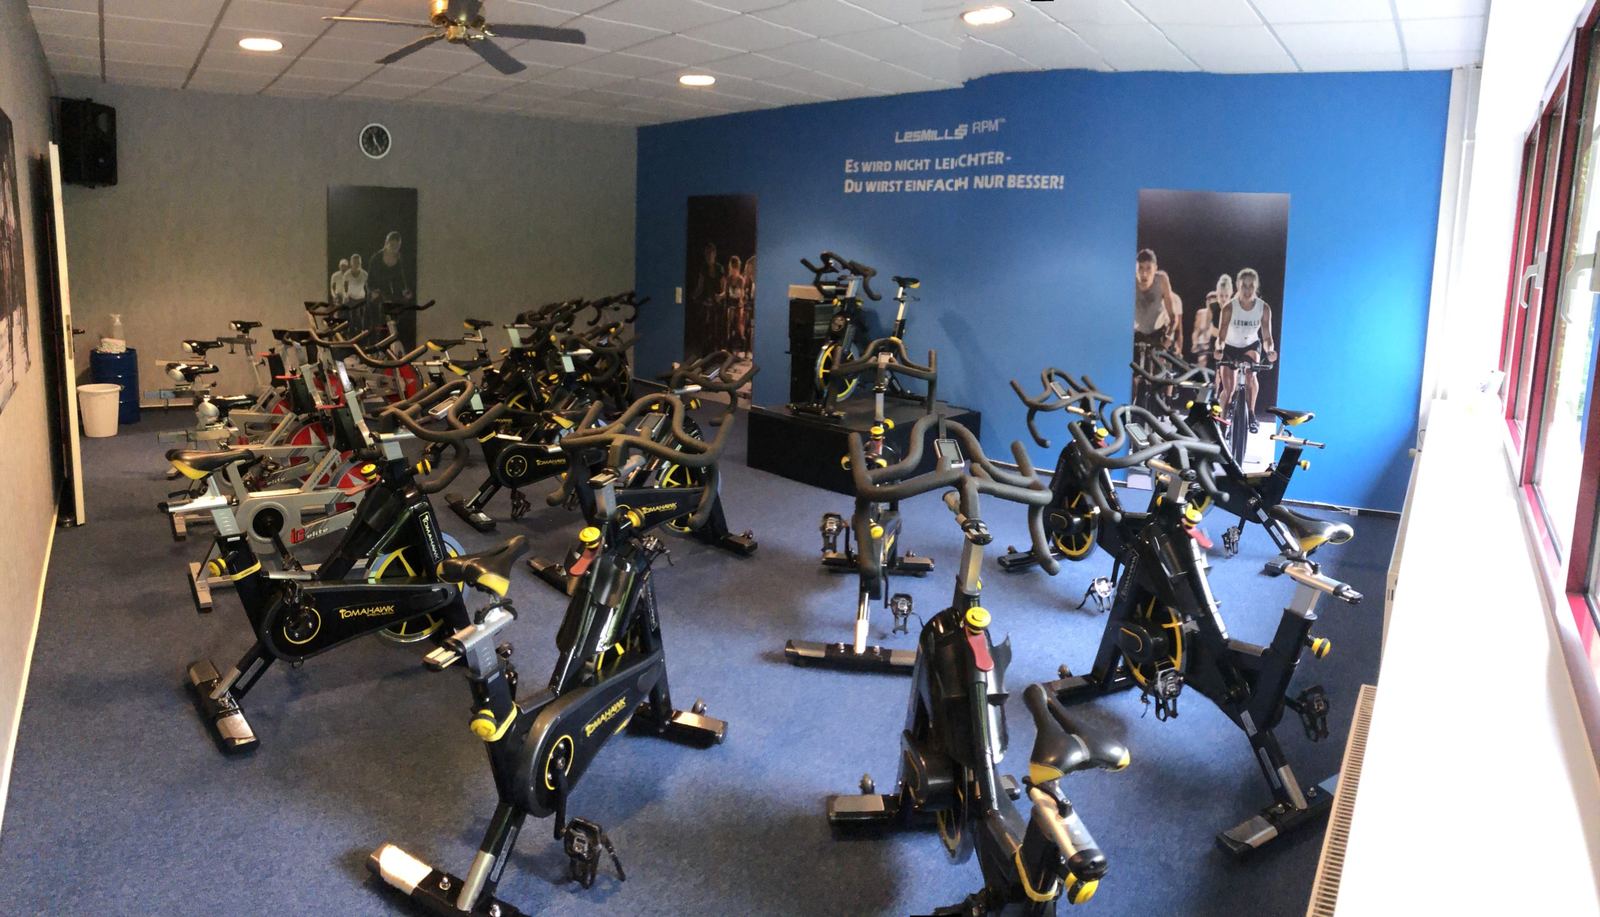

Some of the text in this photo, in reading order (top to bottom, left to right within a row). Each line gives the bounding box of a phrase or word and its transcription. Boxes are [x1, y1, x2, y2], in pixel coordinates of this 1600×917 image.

[861, 161, 892, 173] WIRD
[895, 159, 931, 172] NICHT
[865, 180, 903, 193] WIRST
[905, 176, 969, 192] EINFACH
[973, 175, 1005, 189] NUR
[1007, 174, 1065, 190] BESSER!
[339, 605, 395, 619] TOMAHAWK
